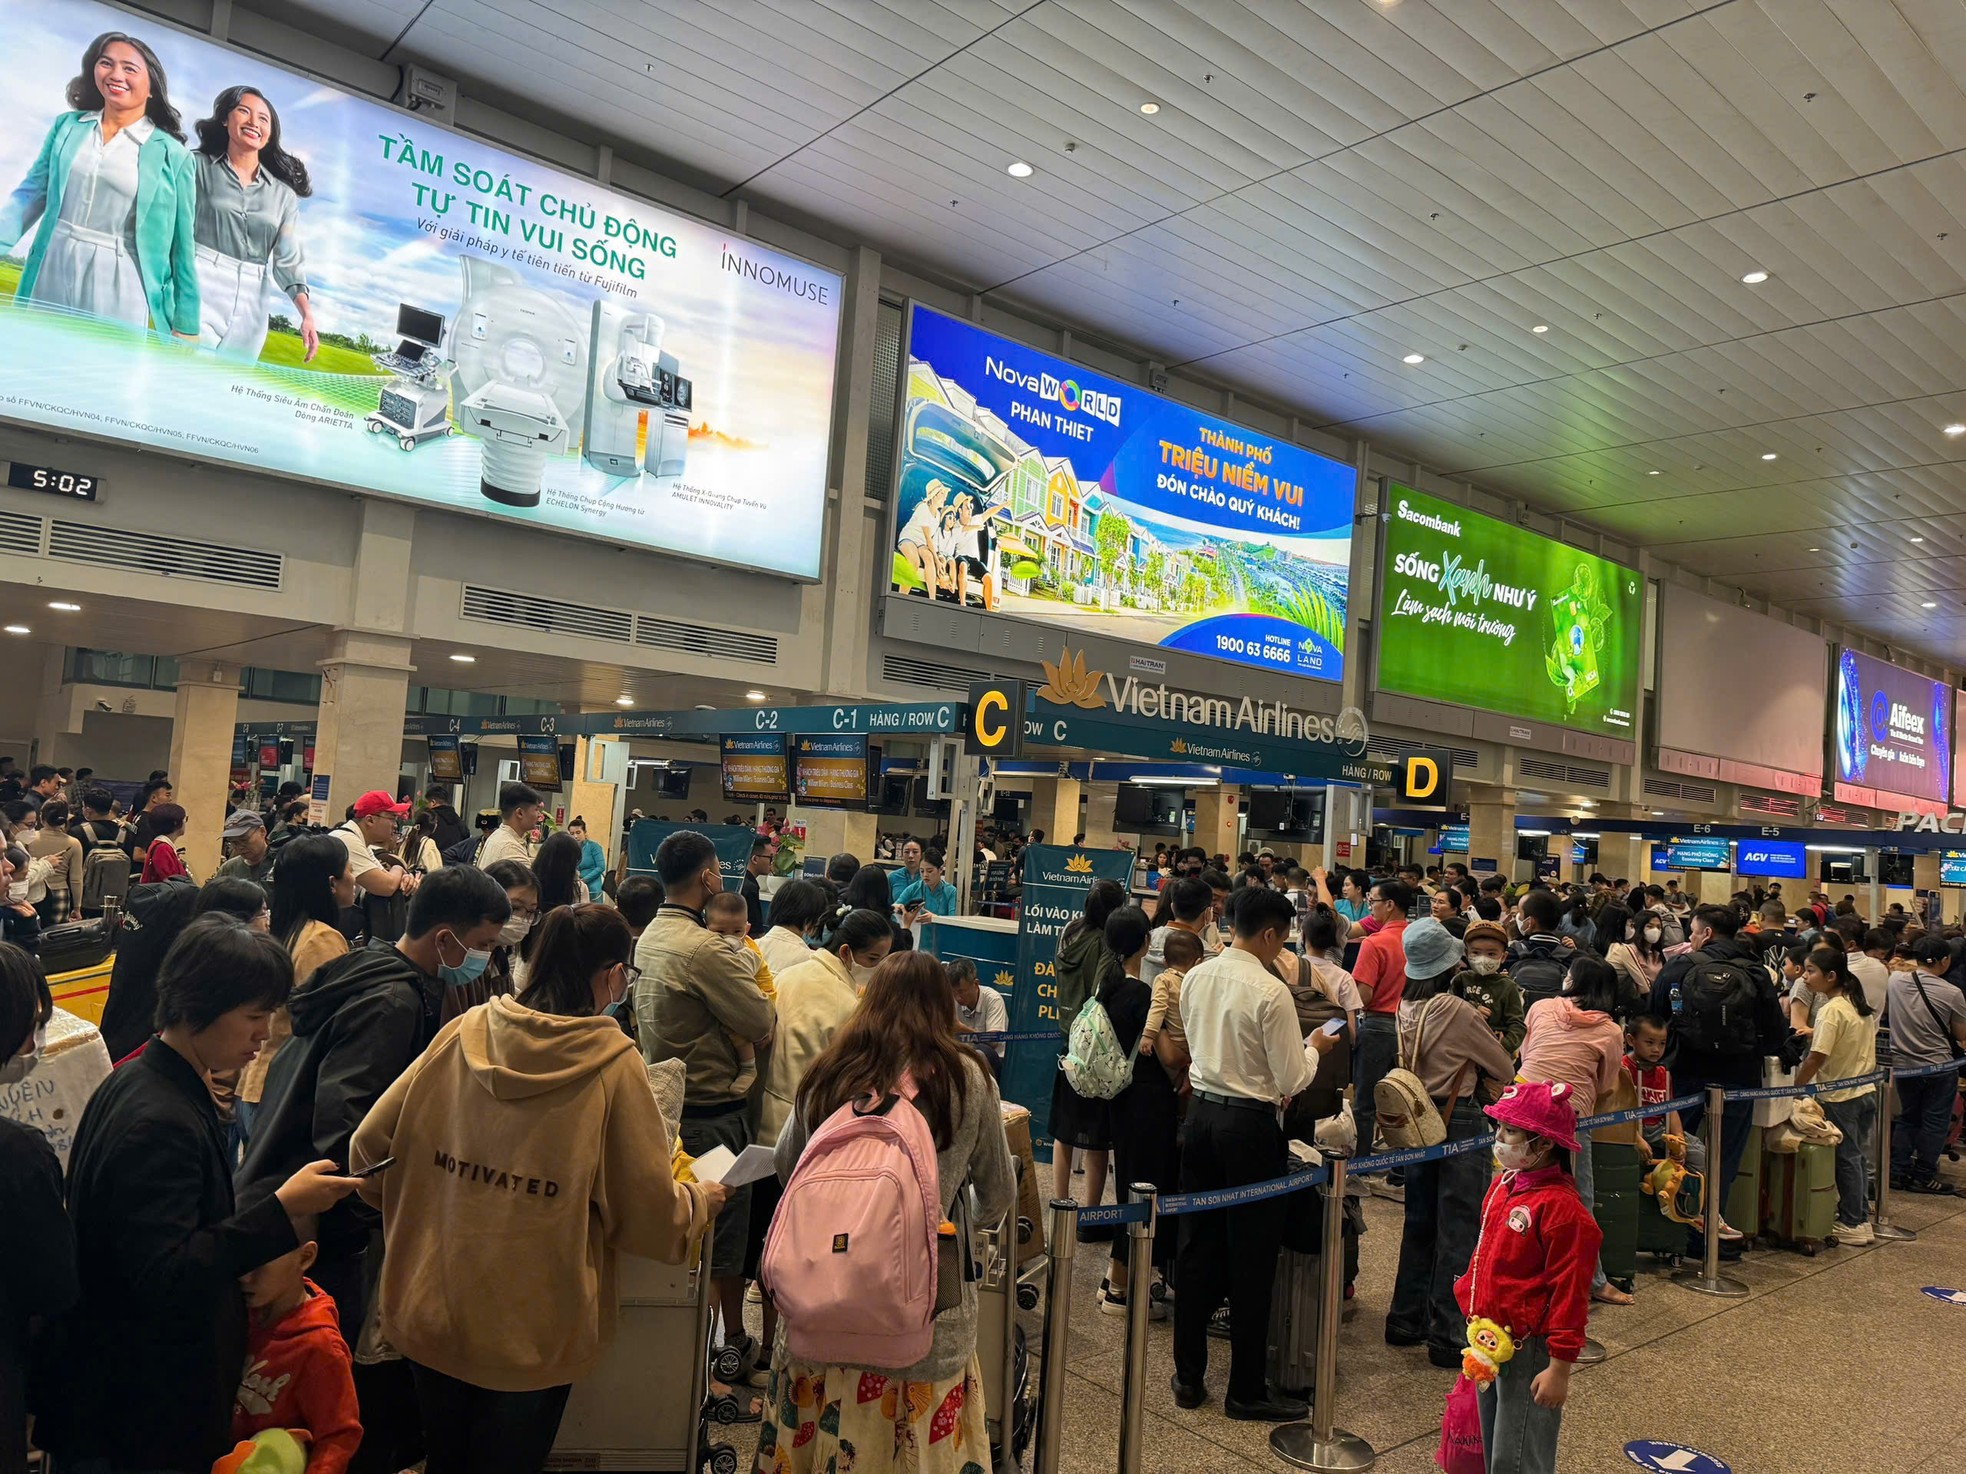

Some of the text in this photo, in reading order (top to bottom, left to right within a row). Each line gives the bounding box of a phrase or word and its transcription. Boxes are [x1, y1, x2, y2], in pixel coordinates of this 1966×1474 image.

[379, 133, 677, 258] TẦM SOÁT CHỦ ĐỘNG
[411, 182, 645, 280] TỰ TIN VUI SỐNG
[417, 217, 638, 299] Với giải pháp y tế tiên tiến từ Fujifilm
[318, 416, 353, 429] ARIETTA
[1010, 401, 1095, 443] PHAN THIET
[1199, 427, 1273, 465] THÀNH PHỐ
[33, 469, 92, 497] 5:02
[1158, 439, 1304, 508] TRIỆU NIỀM VUI
[546, 498, 607, 517] ECHELON Synergy
[672, 492, 734, 510] AMULET INNOVALITY
[1156, 473, 1301, 531] ĐÓN CHÀO QUÝ KHÁCH!
[1397, 500, 1461, 538] Sacombank
[1394, 552, 1440, 583] SỐNG
[1438, 550, 1493, 606] Xanh
[1493, 582, 1526, 608] NHƯ
[1526, 589, 1537, 611] Ý
[1391, 588, 1517, 646] Làm sạch môi trường
[1216, 634, 1291, 663] 1900 63 6666
[1265, 634, 1291, 647] HOTLINE
[1297, 655, 1323, 666] LAND
[833, 708, 857, 729] C-1
[869, 711, 899, 727] HÀNG
[908, 712, 935, 726] ROW
[937, 706, 950, 728] C
[975, 690, 1008, 747] C
[1105, 672, 1336, 745] Vietnam Airlines
[540, 717, 555, 732] C-3
[623, 717, 645, 728] Vietnam
[755, 710, 778, 730] C-2
[1889, 703, 1925, 735] Aifeex
[1024, 720, 1067, 740] OW C
[734, 740, 773, 750] Vietnam Airlines
[811, 742, 853, 752] Vietnam Airlines
[1187, 742, 1251, 762] Vietnam Airlines
[1341, 763, 1367, 779] HÀNG
[1372, 768, 1392, 782] ROW
[1405, 756, 1438, 798] D
[1693, 824, 1711, 834] E-6
[1761, 827, 1780, 836] E-5
[1744, 852, 1769, 862] ACV
[1042, 871, 1079, 883] Vietnam
[1025, 903, 1070, 920] LỐI VÀO
[1026, 921, 1052, 936] LÀM
[959, 1034, 979, 1043] TIA
[1815, 1083, 1827, 1092] TIA
[1624, 1111, 1637, 1120] TIA
[1442, 1143, 1459, 1156] TIA
[1357, 1158, 1375, 1169] KHÔNG
[434, 1150, 559, 1198] MOTIVATED
[1192, 1194, 1206, 1206] TAN
[1239, 1181, 1288, 1200] INTERNATIONAL
[1288, 1173, 1313, 1188] AIRPORT
[1079, 1208, 1124, 1222] AIRPORT
